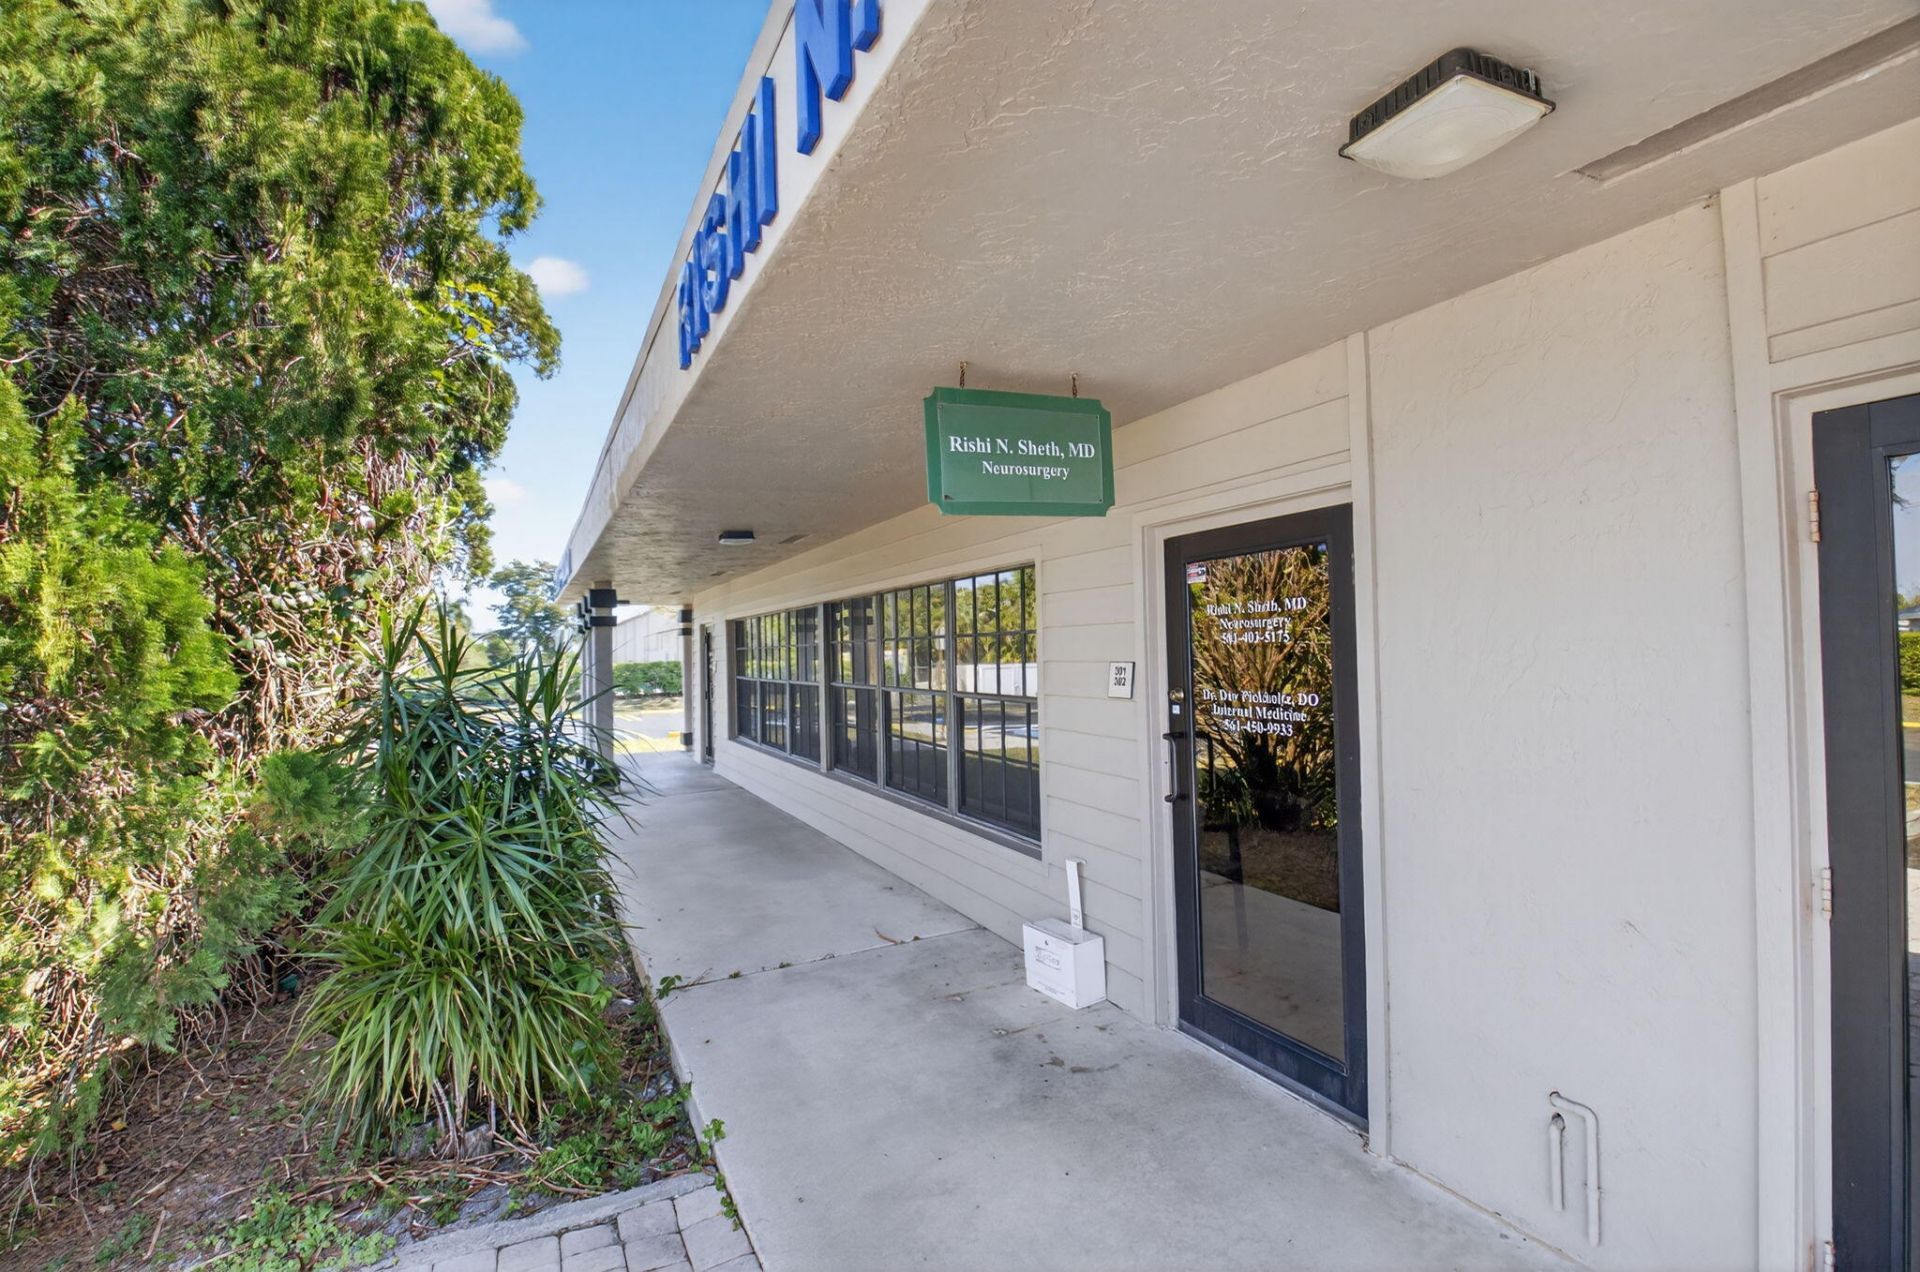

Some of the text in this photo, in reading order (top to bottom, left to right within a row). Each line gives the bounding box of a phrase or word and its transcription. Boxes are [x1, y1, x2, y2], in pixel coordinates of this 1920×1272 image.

[676, 75, 778, 371] RISHI
[949, 435, 1095, 460] Rishi N. Sheth, MD
[982, 461, 1070, 480] Neurosurgery
[1284, 596, 1307, 612] MD
[1220, 617, 1291, 630] Neurosurgery
[1203, 688, 1217, 701] Dr.
[1298, 692, 1319, 707] DO
[1212, 703, 1307, 722] Internal Medicine
